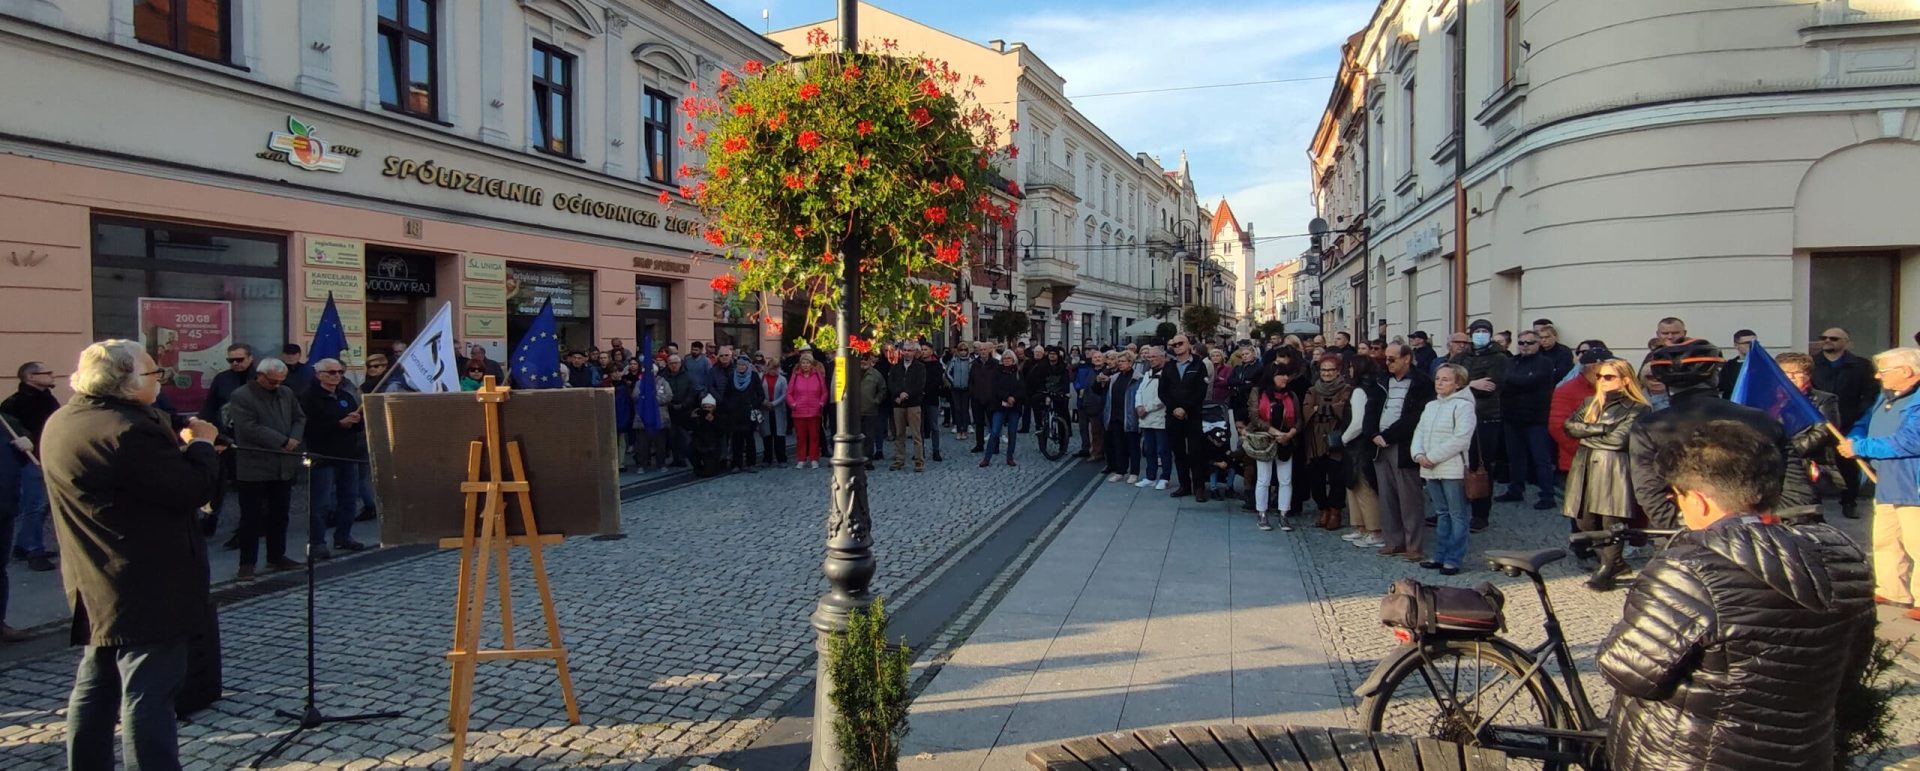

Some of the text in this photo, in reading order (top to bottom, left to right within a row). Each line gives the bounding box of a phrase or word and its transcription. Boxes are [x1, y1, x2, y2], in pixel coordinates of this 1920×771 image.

[383, 155, 703, 238] SPÓŁDZIELNIA OGRODNICZA ZIEM
[406, 220, 420, 236] 18
[311, 272, 358, 280] KANCELARIA
[311, 279, 359, 287] ADWOKACKA
[365, 279, 431, 293] WOCOWY RAJ
[175, 314, 210, 323] 200 GB
[188, 329, 202, 339] 45
[410, 350, 429, 375] komitet
